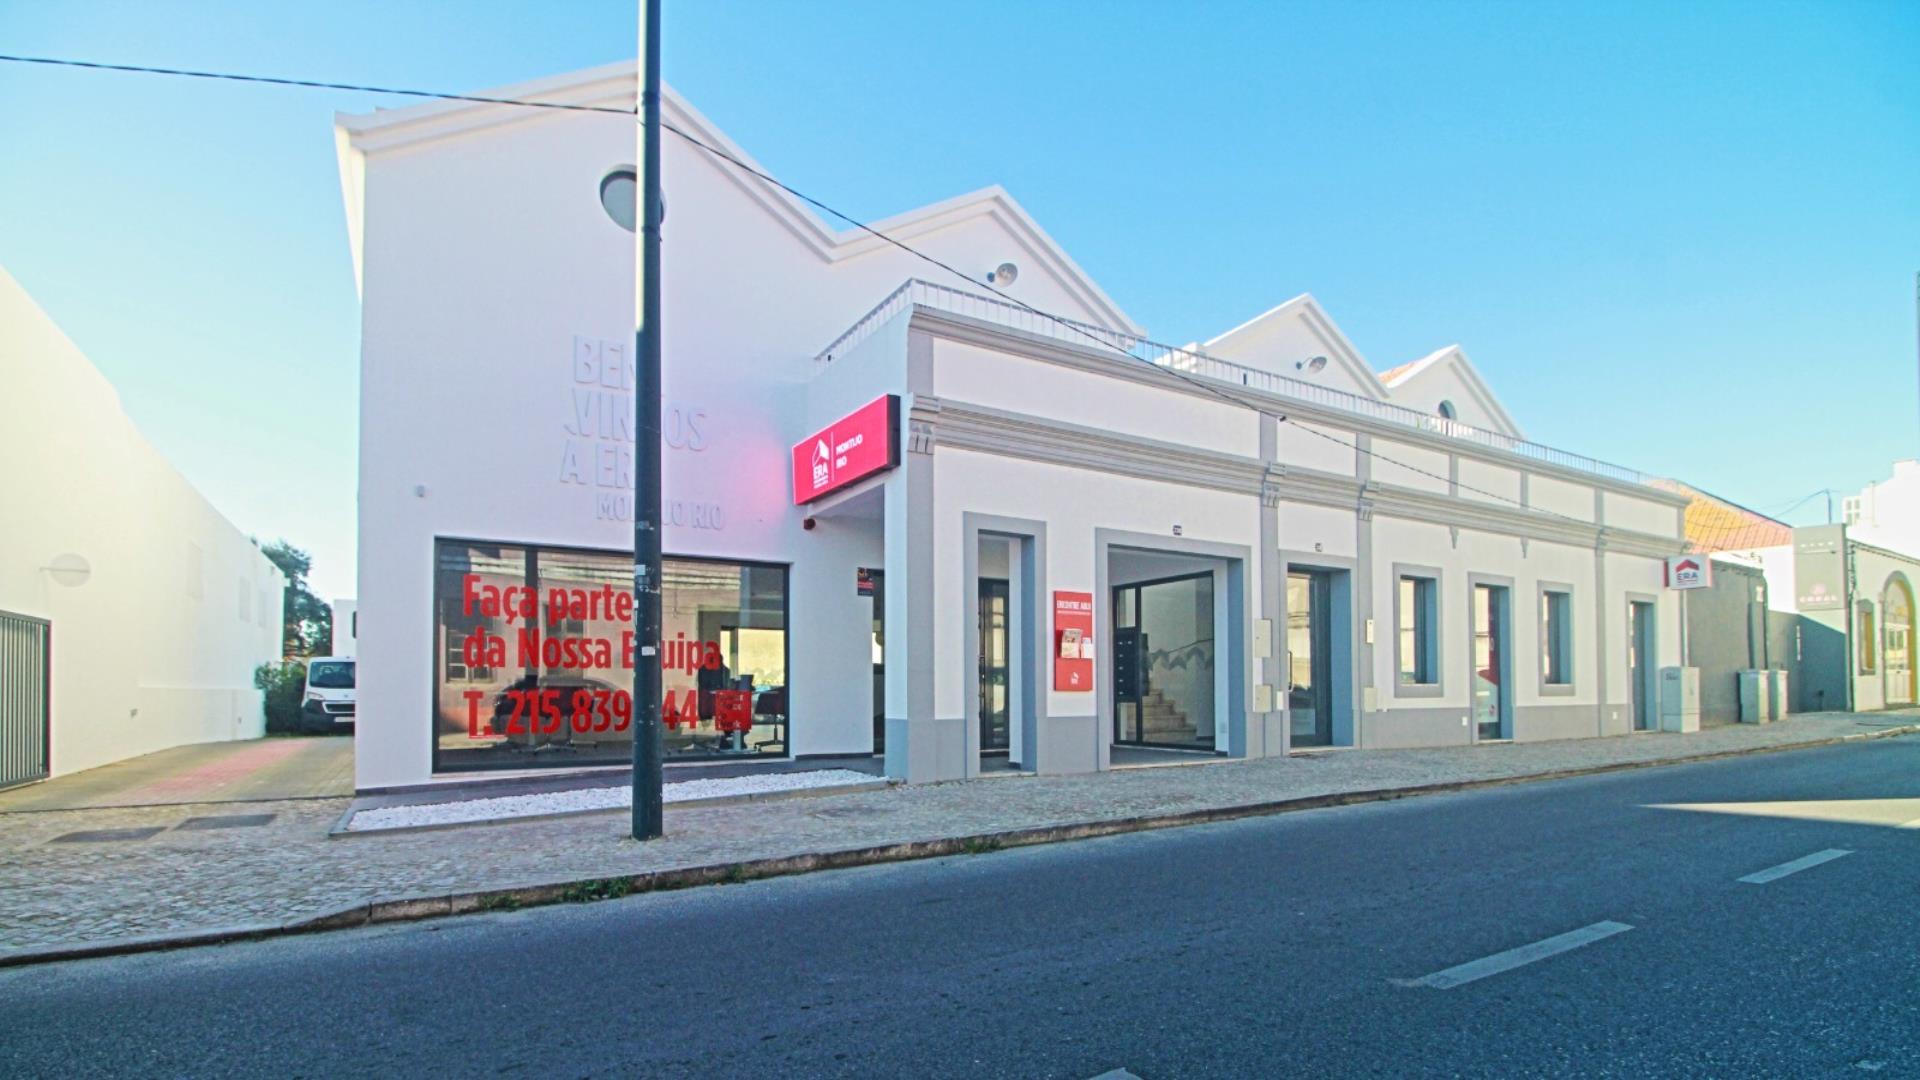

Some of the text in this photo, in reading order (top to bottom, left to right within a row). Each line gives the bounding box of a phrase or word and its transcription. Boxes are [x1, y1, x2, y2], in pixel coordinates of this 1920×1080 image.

[571, 387, 711, 452] VINOS
[595, 441, 636, 490] ER
[813, 462, 828, 479] ERA
[596, 493, 727, 532] MOJO RIO
[463, 573, 633, 626] Faça parte
[1676, 572, 1698, 581] ERA
[463, 626, 720, 675] da Nossa Euipa
[463, 688, 699, 738] T. 215 839 44
